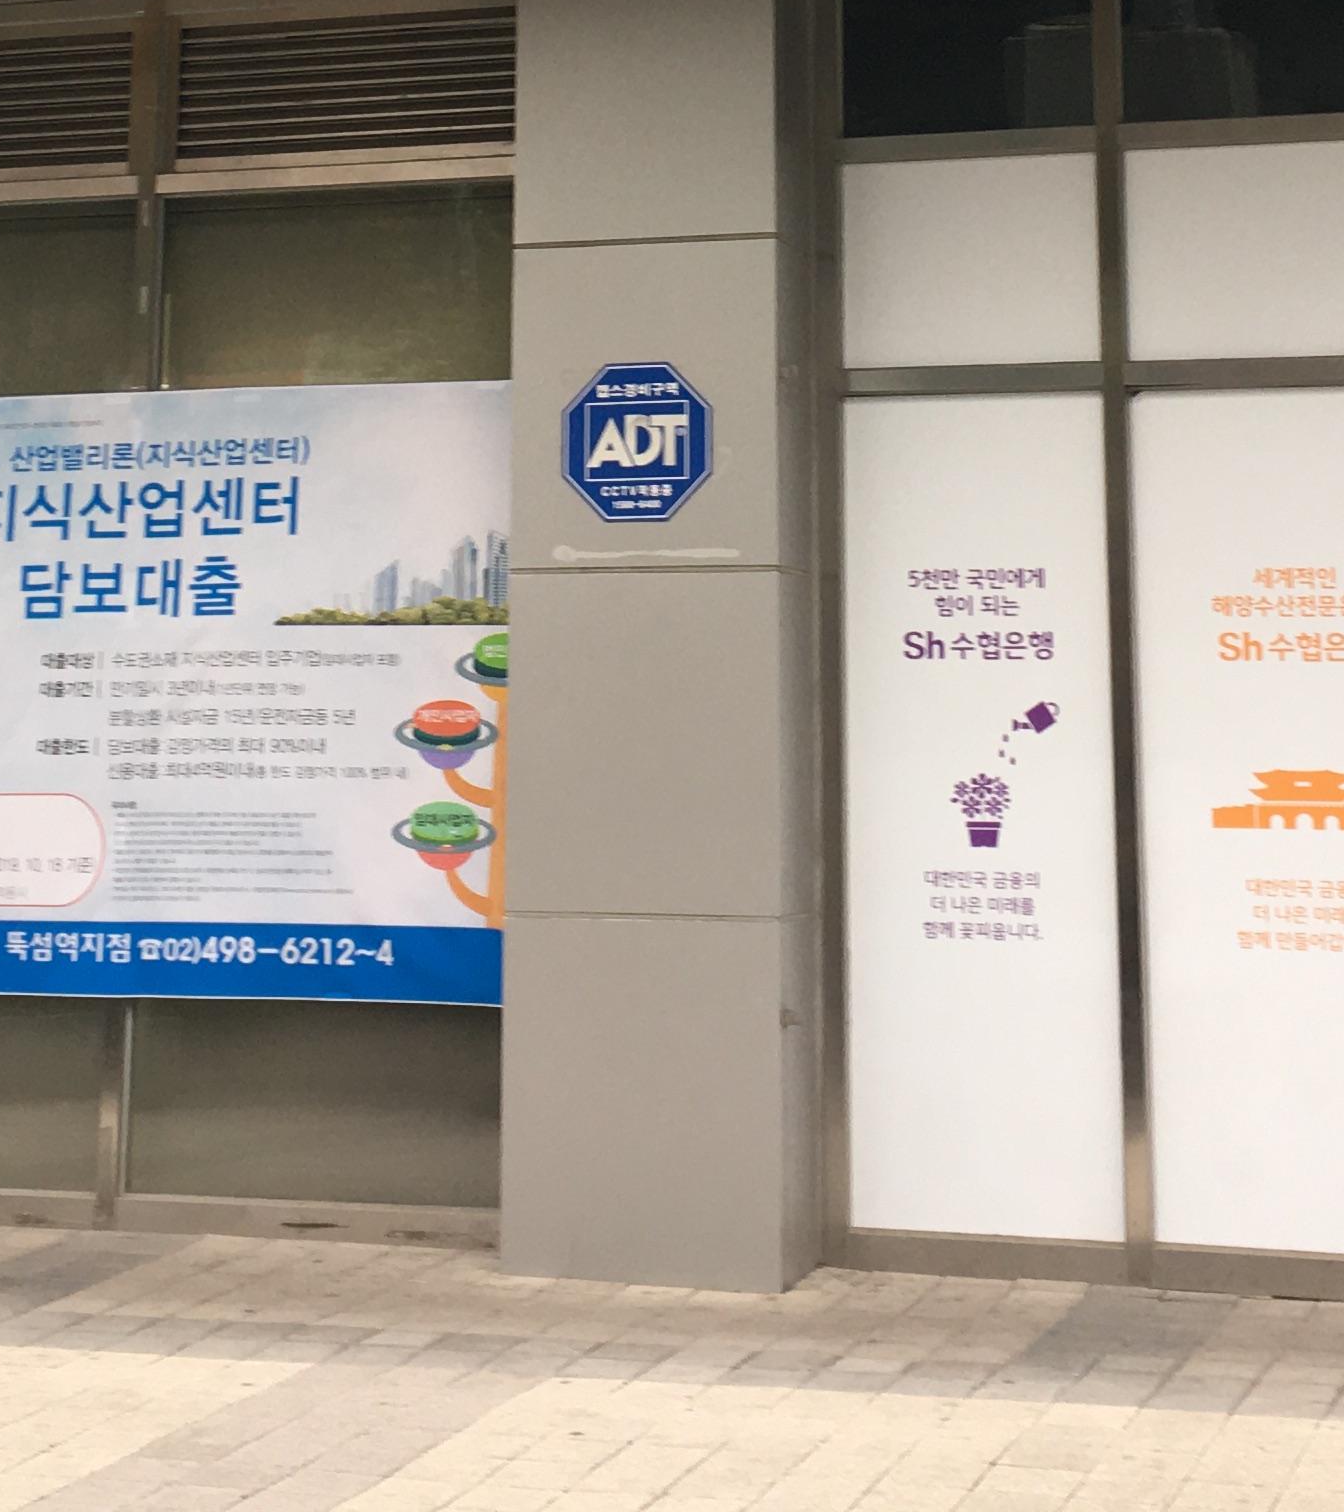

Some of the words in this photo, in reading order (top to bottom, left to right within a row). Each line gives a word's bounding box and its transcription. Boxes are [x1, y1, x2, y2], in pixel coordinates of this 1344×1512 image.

[585, 414, 688, 468] ADT
[9, 435, 310, 472] 산업밸리론(지식산업센터)
[19, 555, 241, 620] 담보대출
[907, 568, 960, 589] 5천만
[966, 568, 1046, 590] 국민에게
[1253, 566, 1337, 589] 세계적인
[935, 595, 975, 617] 힘이
[980, 595, 1020, 616] 되는
[903, 631, 945, 660] Sh
[950, 631, 1055, 661] 수협은행
[1218, 632, 1263, 661] Sh
[923, 870, 988, 890] 대한민국
[993, 870, 1042, 890] 금융의
[1244, 878, 1313, 899] 대한민국
[930, 896, 946, 913] 더
[951, 896, 982, 915] 나은
[988, 896, 1035, 916] 미래를
[1252, 905, 1270, 923] 더
[1274, 905, 1308, 924] 나은
[922, 921, 955, 941] 함께
[1236, 931, 1271, 950] 함께
[5, 931, 132, 963] 뚝섬역지점
